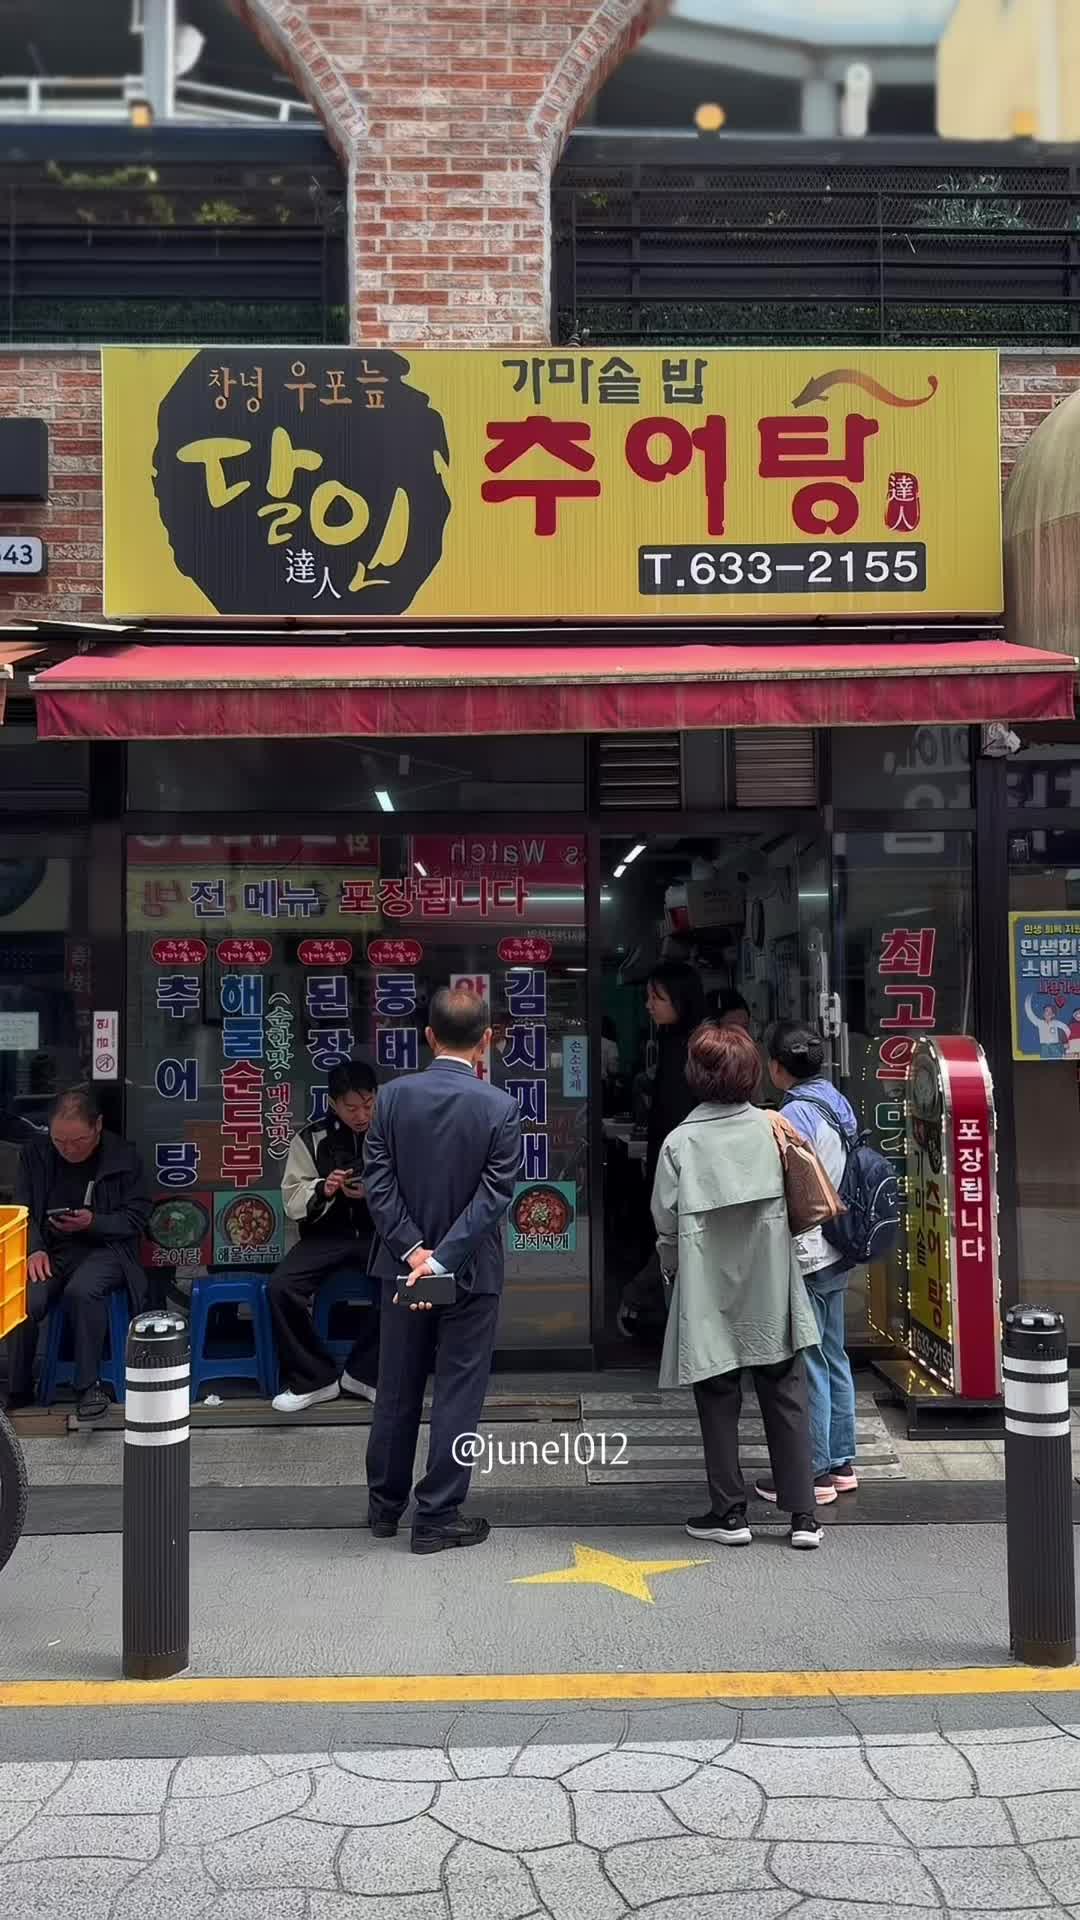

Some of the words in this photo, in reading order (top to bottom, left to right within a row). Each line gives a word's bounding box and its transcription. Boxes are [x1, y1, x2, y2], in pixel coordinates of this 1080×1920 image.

[208, 366, 262, 413] 창녕
[284, 360, 389, 413] 우포늪
[502, 357, 641, 404] 가마솥
[661, 357, 708, 404] 밥
[481, 413, 880, 537] 추어탕
[176, 426, 411, 592] 달인
[888, 474, 919, 532] 達人
[0, 544, 33, 565] 43
[285, 548, 341, 600] 達人
[643, 549, 919, 588] T.633-2155
[190, 879, 225, 917] 전
[244, 879, 319, 918] 메뉴
[338, 876, 530, 918] 포장됩니다
[1021, 938, 1080, 956] 민생회
[1022, 959, 1080, 977] 소비쿠
[155, 974, 201, 1188] 추어탕
[220, 974, 264, 1188] 해물순두부
[957, 1119, 986, 1263] 포장됩니다
[152, 1247, 202, 1265] 추어탕
[216, 1244, 281, 1264] 해물순두부
[513, 1232, 569, 1251] 김치찌개
[926, 1179, 944, 1330] 추어탕
